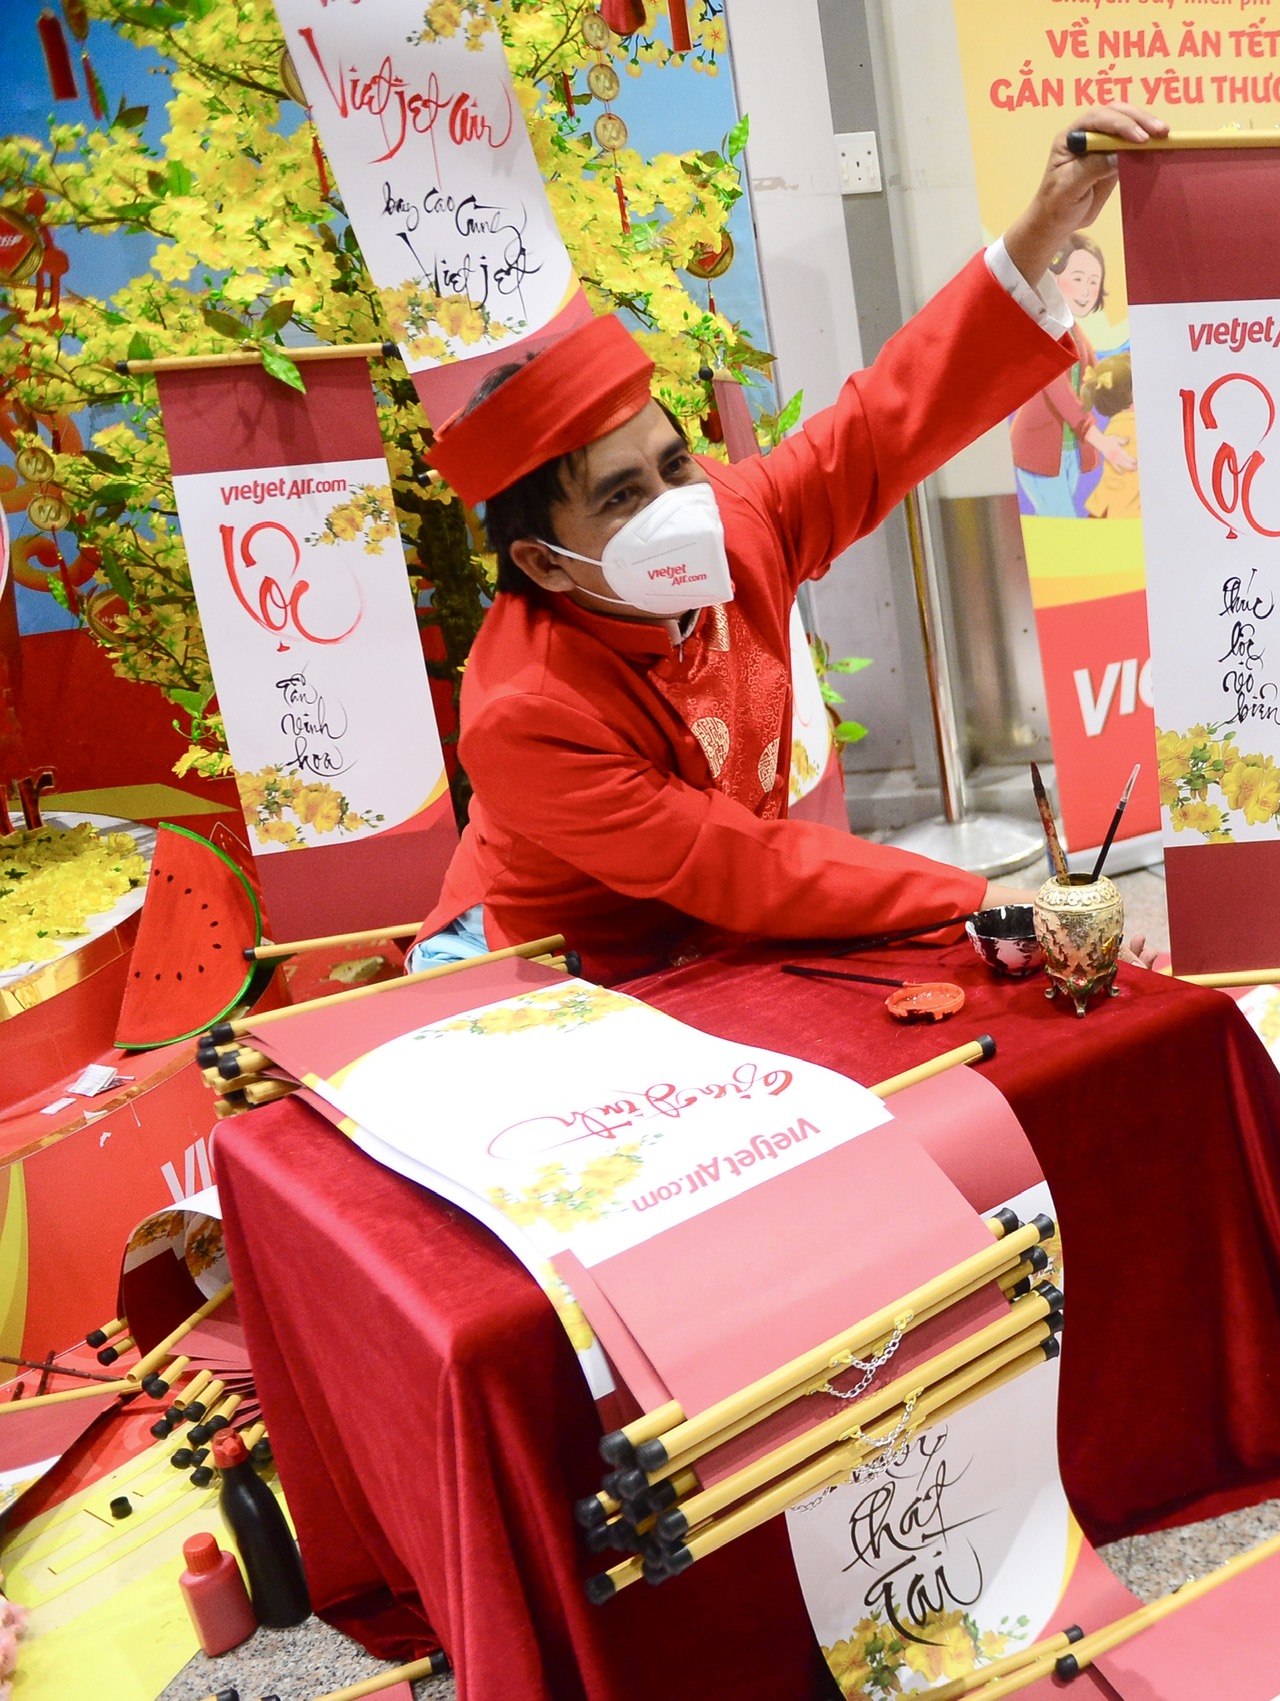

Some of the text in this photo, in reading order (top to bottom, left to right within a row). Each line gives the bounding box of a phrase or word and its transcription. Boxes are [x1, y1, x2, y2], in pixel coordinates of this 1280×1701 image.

[1046, 16, 1090, 59] VỀ
[1100, 22, 1170, 59] NHÀ
[1178, 20, 1221, 58] ĂN
[990, 59, 1064, 112] GẮN
[1074, 63, 1133, 106] KẾT
[1140, 68, 1205, 105] YÊU
